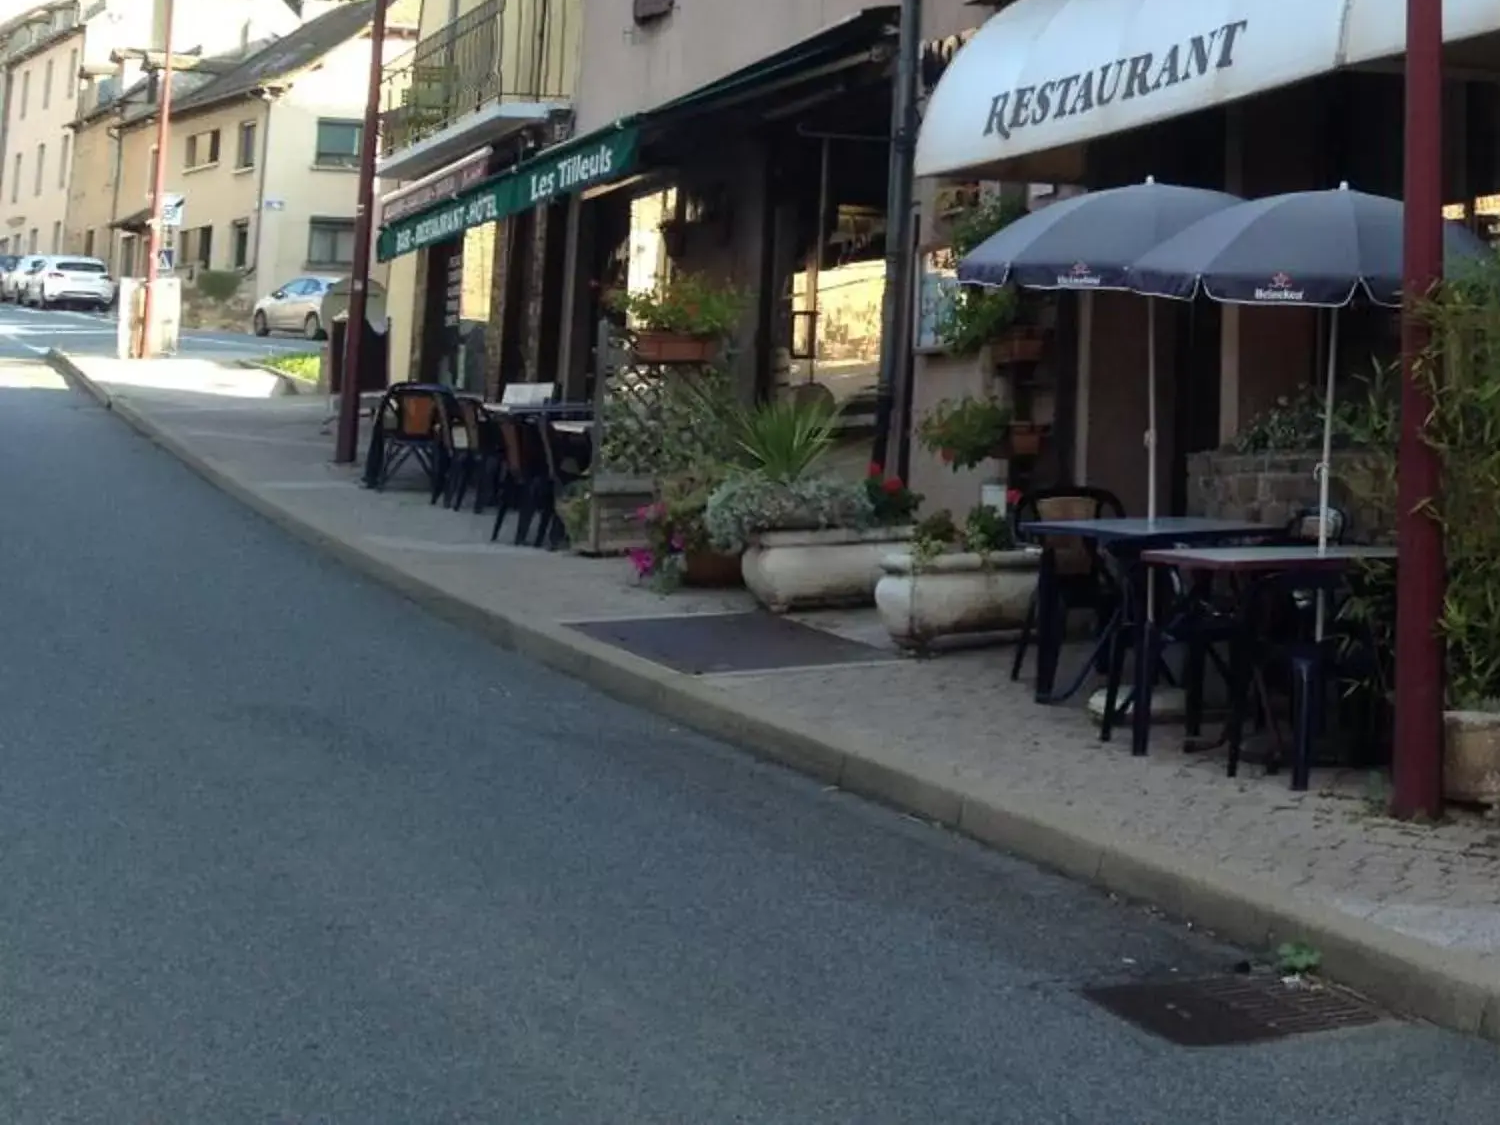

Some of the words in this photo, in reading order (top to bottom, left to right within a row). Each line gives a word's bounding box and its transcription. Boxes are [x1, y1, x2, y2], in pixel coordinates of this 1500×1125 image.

[982, 20, 1248, 140] RESTAURANT
[530, 172, 555, 201] Les
[557, 145, 613, 188] Tilleuls
[1254, 287, 1304, 300] Heineken
